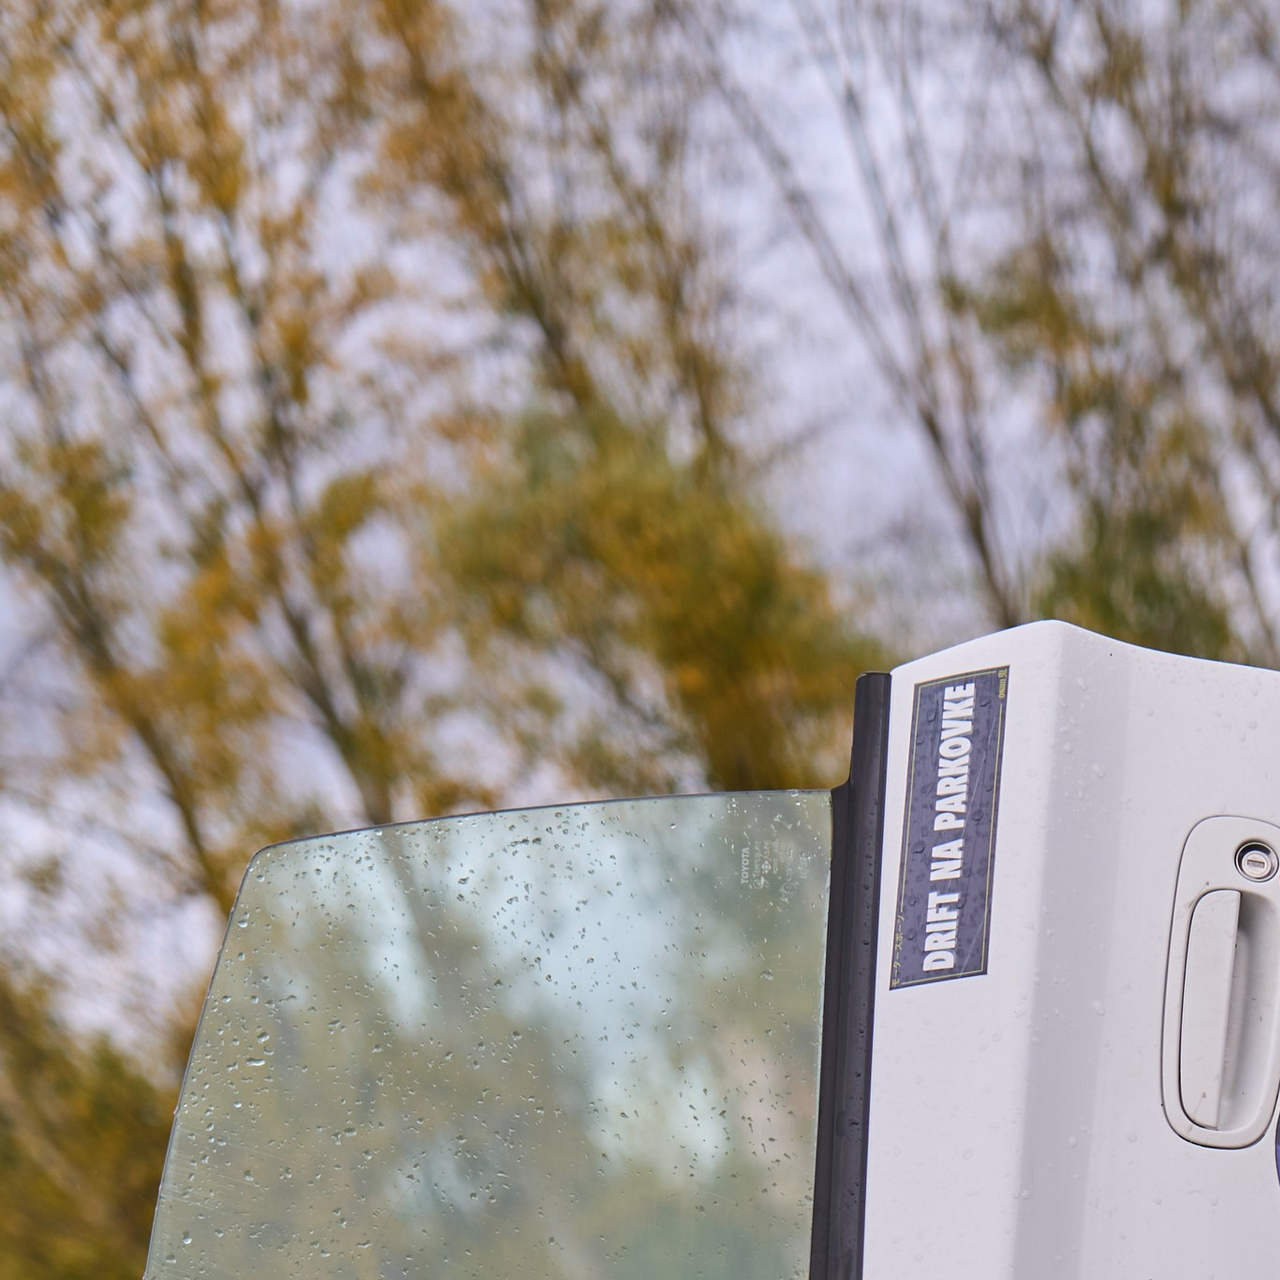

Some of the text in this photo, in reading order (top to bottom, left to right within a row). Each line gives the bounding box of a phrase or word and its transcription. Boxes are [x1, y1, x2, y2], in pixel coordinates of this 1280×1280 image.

[741, 847, 750, 885] TOYOTA
[923, 682, 976, 972] DRIFT NA PARKOVKE
